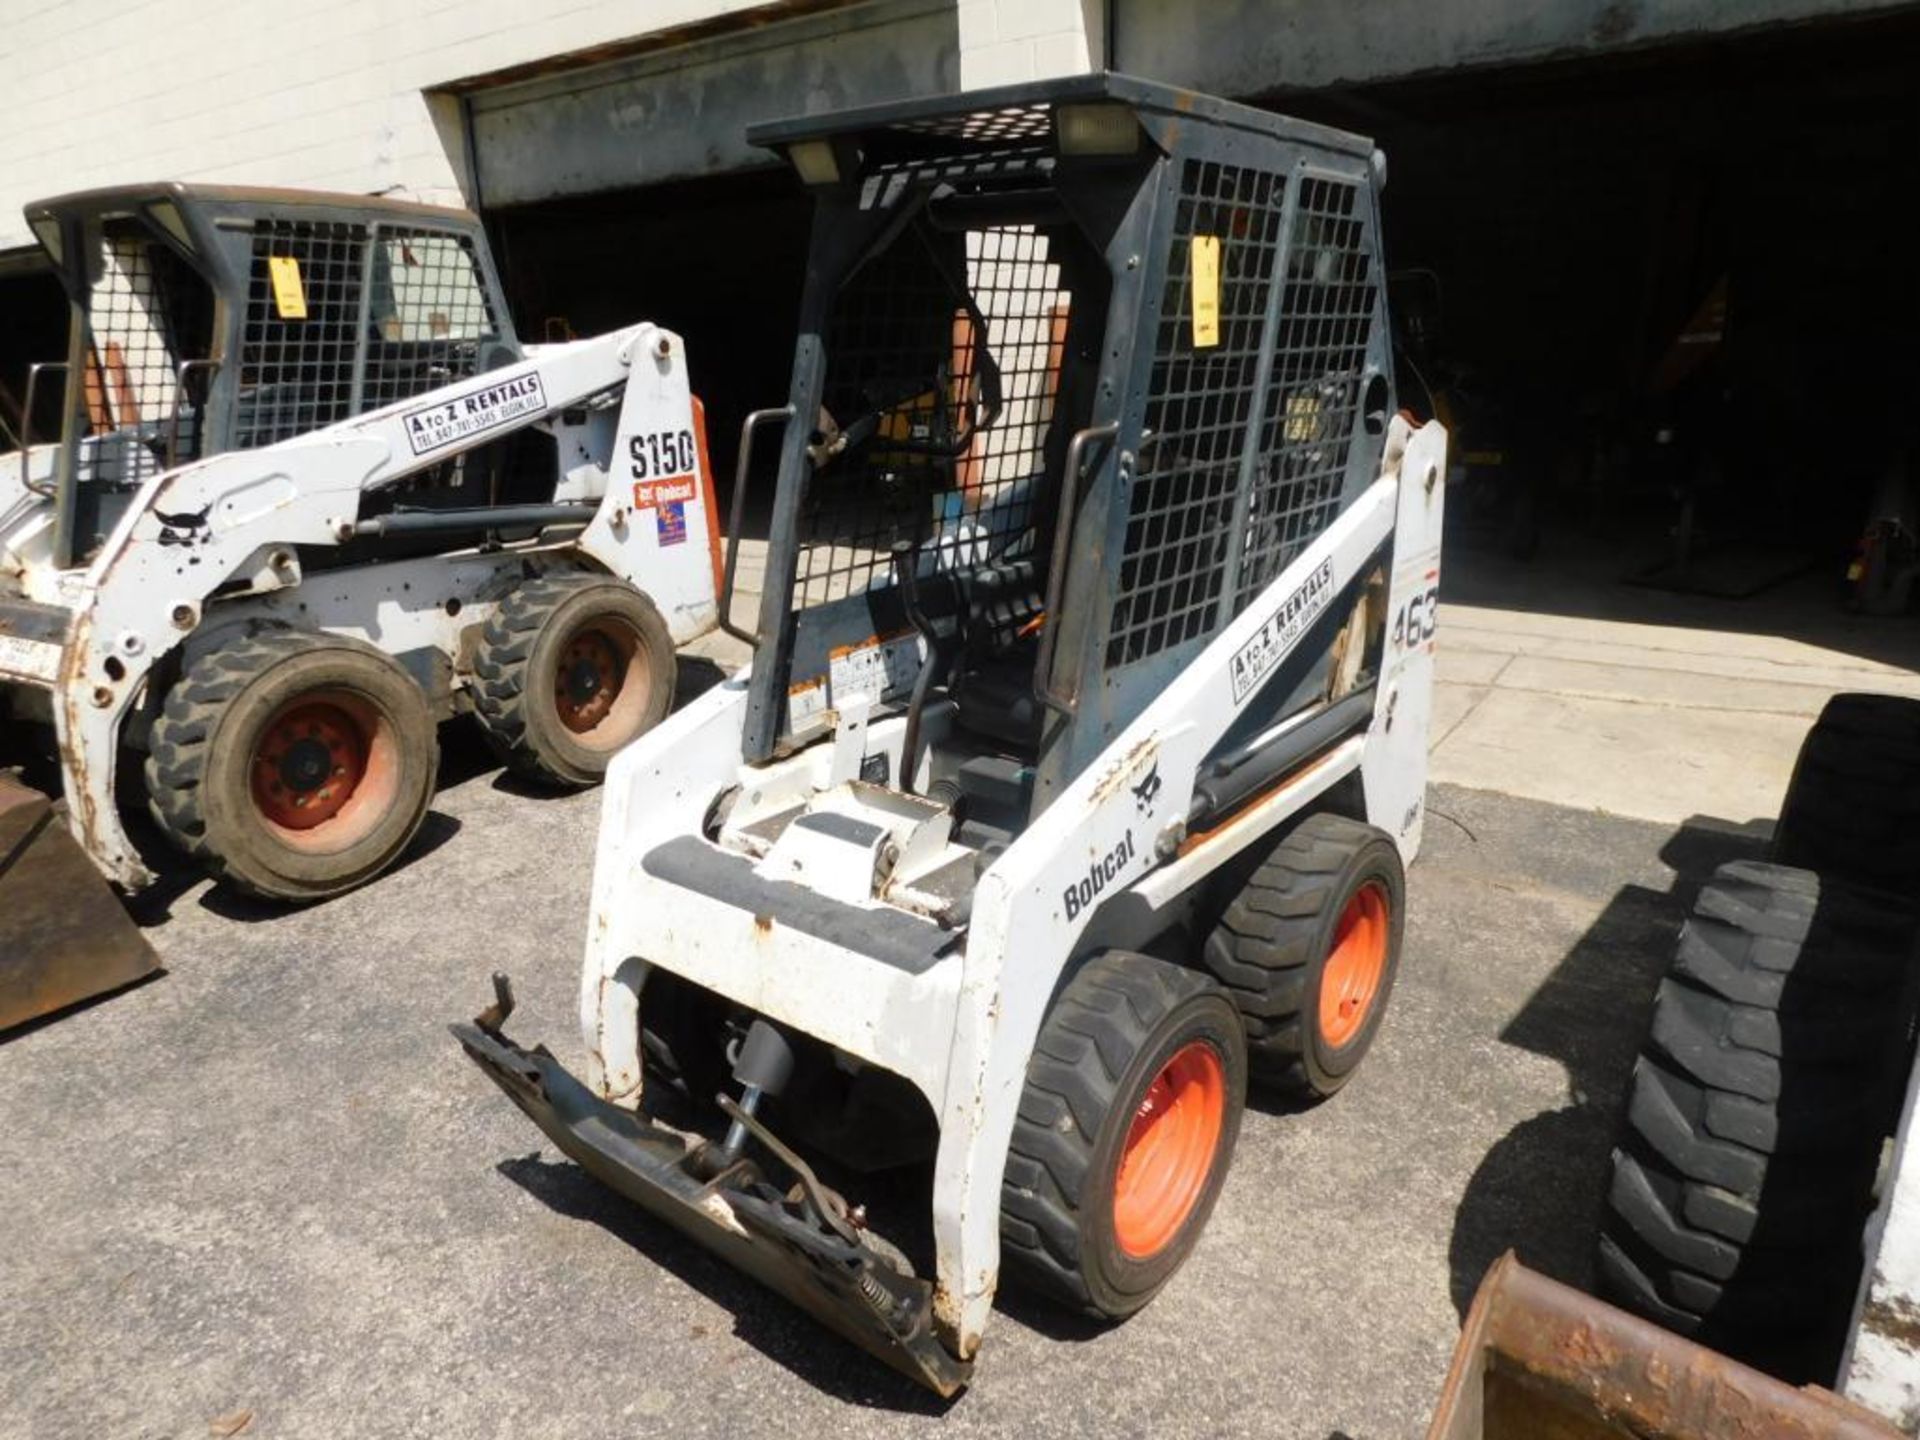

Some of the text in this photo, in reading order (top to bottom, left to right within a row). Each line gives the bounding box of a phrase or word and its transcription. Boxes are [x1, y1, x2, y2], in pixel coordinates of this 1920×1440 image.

[411, 377, 538, 433] A to Z RENTALS
[629, 429, 694, 480] S150
[1235, 562, 1331, 679] A to Z RENTALS
[1063, 826, 1135, 923] Bobcat
